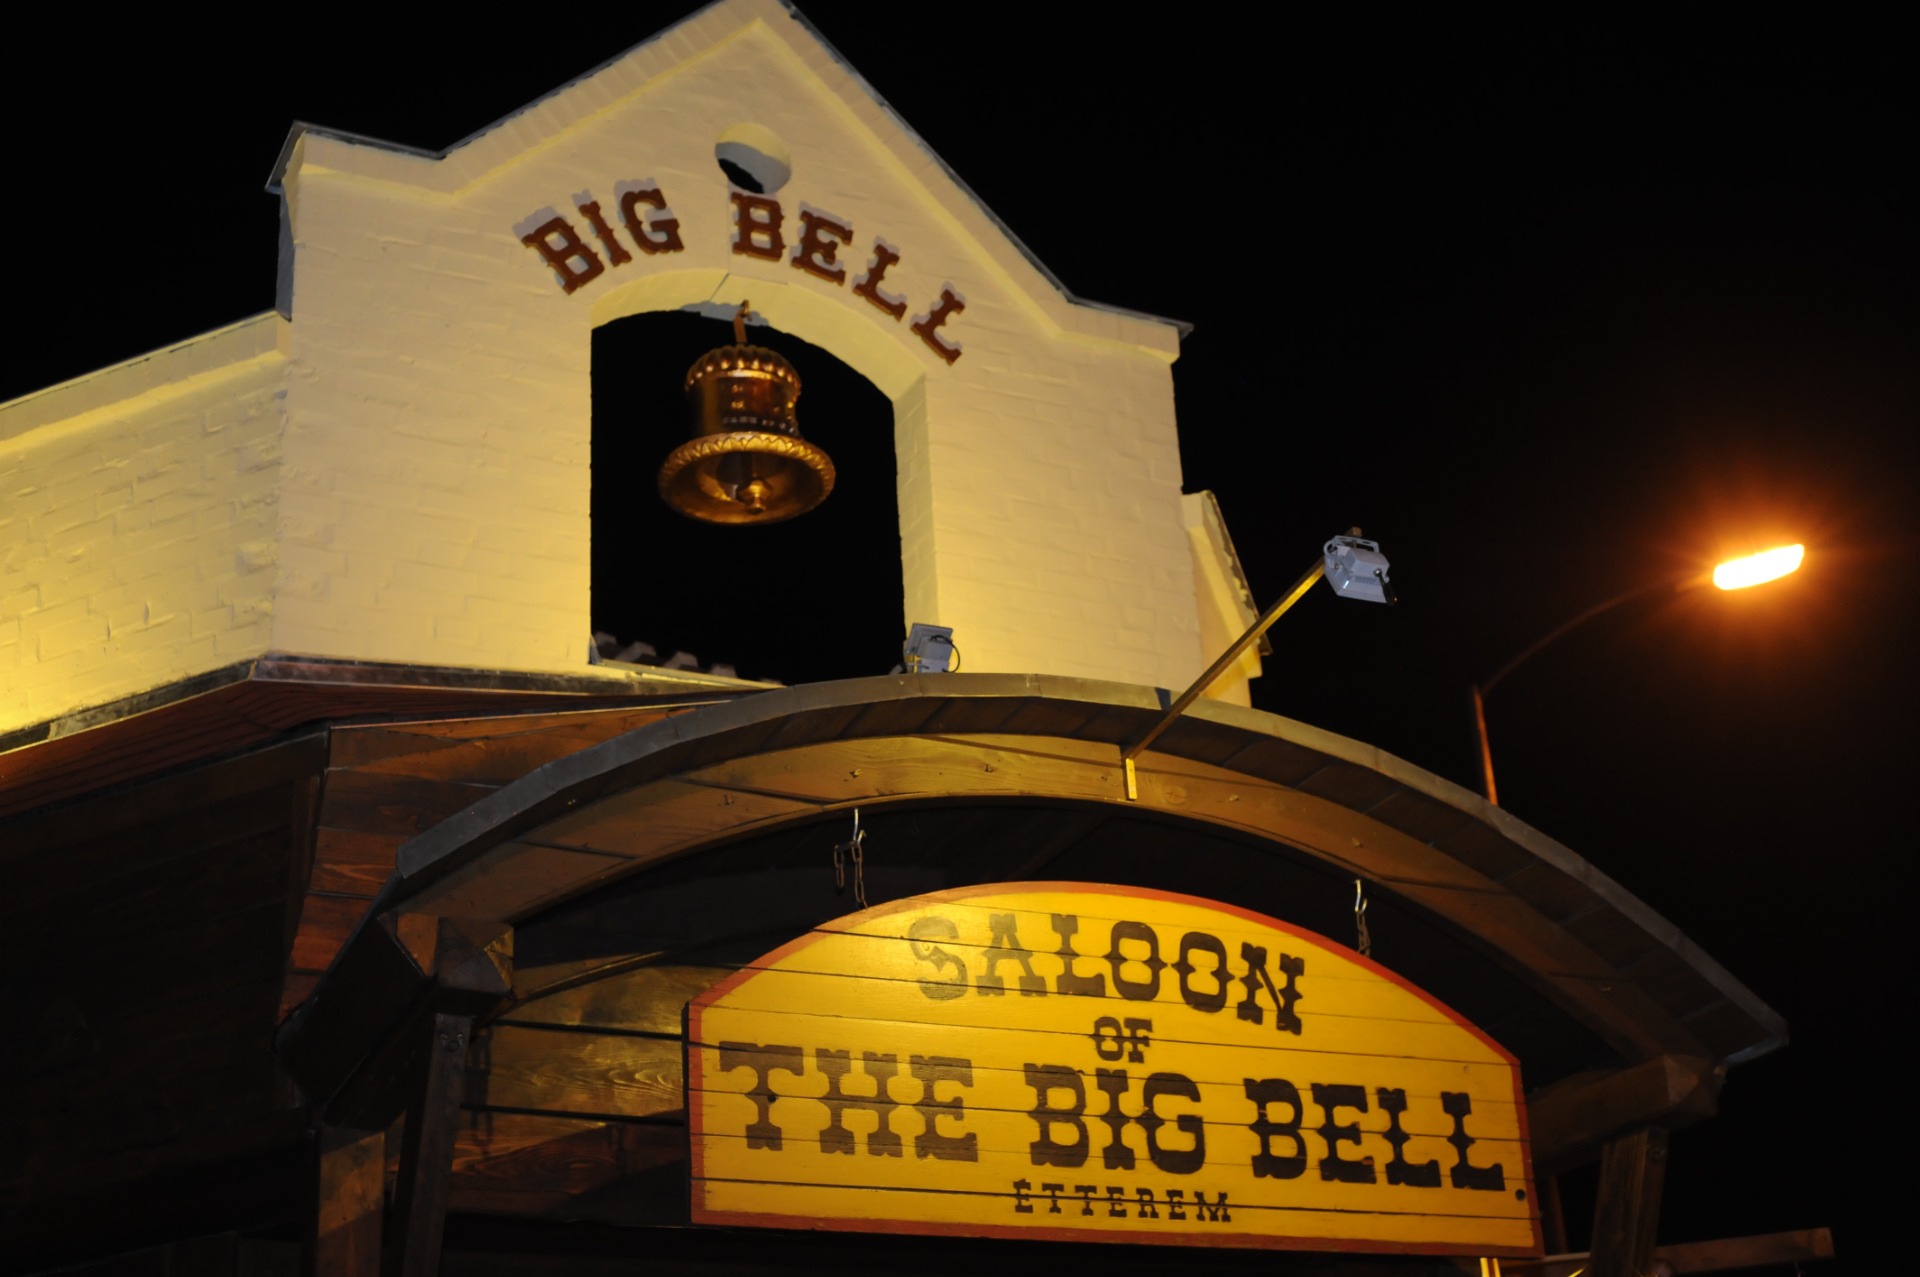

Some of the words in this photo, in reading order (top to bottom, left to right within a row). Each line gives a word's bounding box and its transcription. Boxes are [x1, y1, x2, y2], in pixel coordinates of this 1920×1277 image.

[521, 188, 684, 295] BIG
[731, 191, 965, 365] BELL
[907, 913, 1305, 1036] SALOON
[1091, 1016, 1153, 1063] OF
[719, 1041, 978, 1162] THE
[1023, 1062, 1206, 1175] BIG
[1244, 1078, 1505, 1192] BELL
